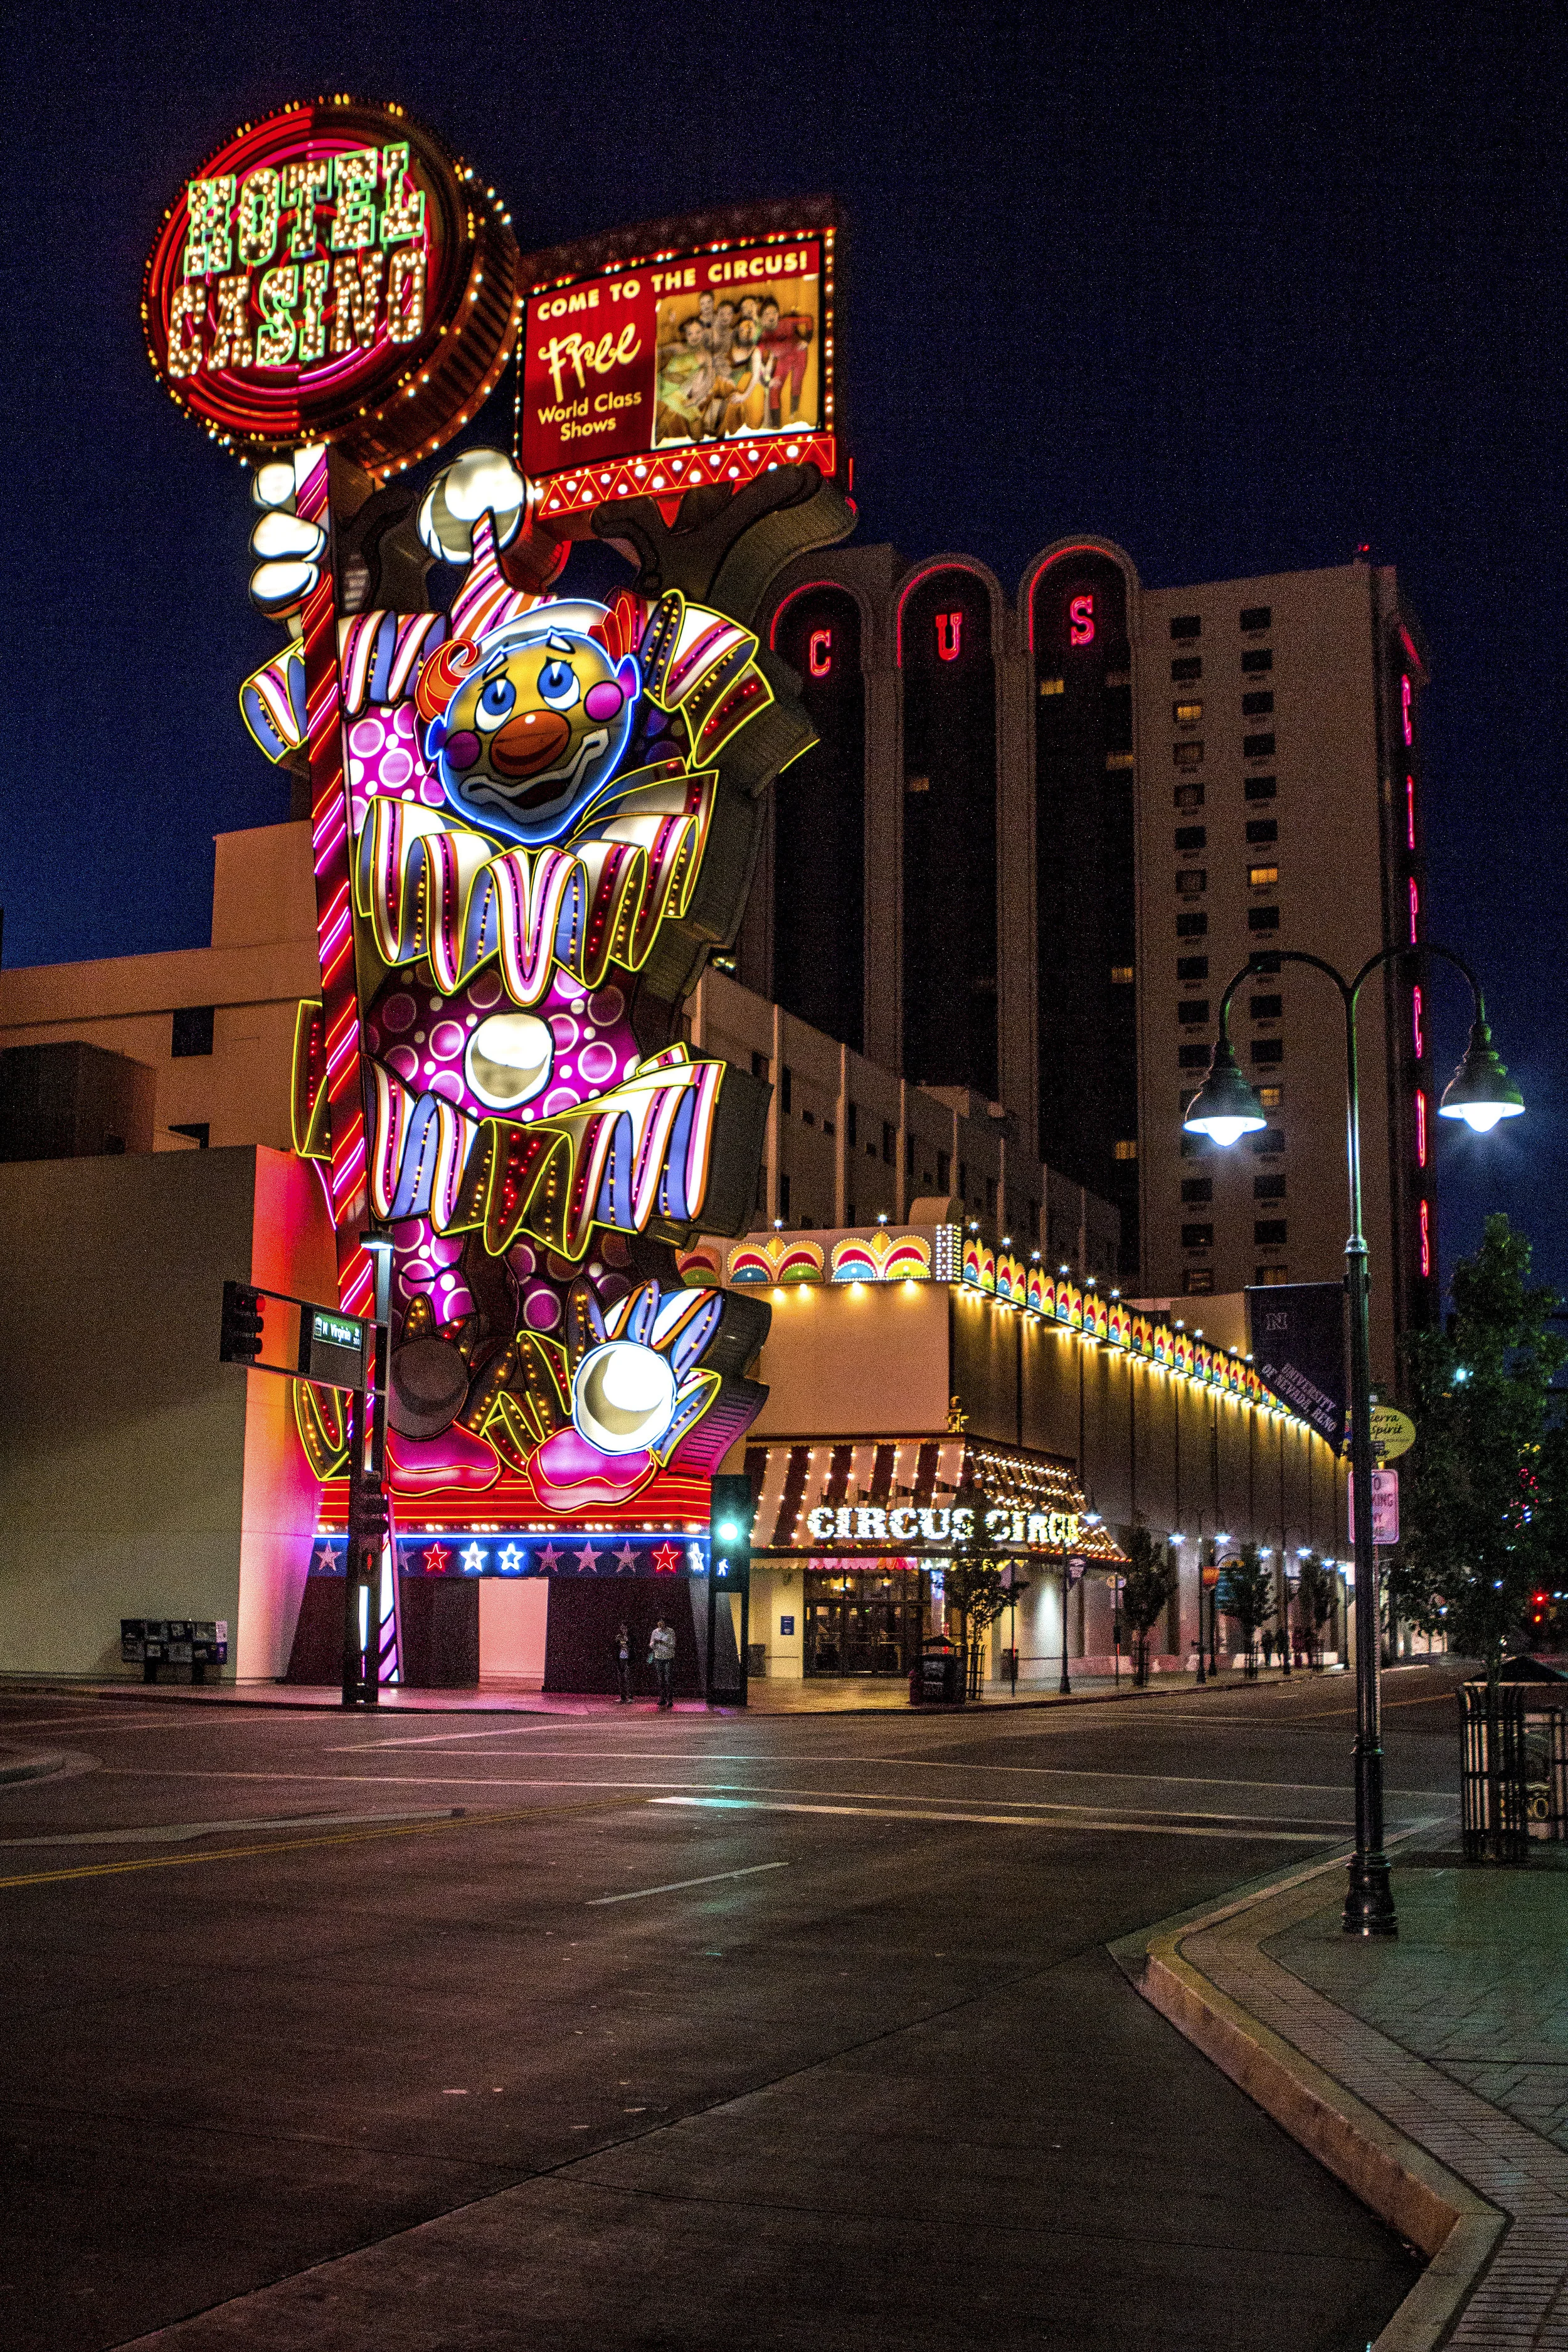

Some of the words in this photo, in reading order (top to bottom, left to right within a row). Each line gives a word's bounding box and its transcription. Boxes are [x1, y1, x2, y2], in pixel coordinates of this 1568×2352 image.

[184, 142, 425, 275] HOTEL
[167, 250, 426, 378] CASINO
[537, 289, 599, 321] COME
[610, 280, 640, 302] TO
[652, 268, 696, 292] THE
[708, 250, 808, 283] CIRCUS!
[538, 323, 642, 402] Free
[538, 400, 588, 425] World
[594, 389, 642, 412] Class
[560, 417, 617, 441] Shows
[322, 1321, 328, 1335] N
[330, 1323, 351, 1343] Virginia
[1261, 1363, 1278, 1379] OF
[1311, 1407, 1338, 1433] RENO
[1281, 1362, 1337, 1412] UNIVERSITY
[806, 1507, 975, 1540] CIRCUS
